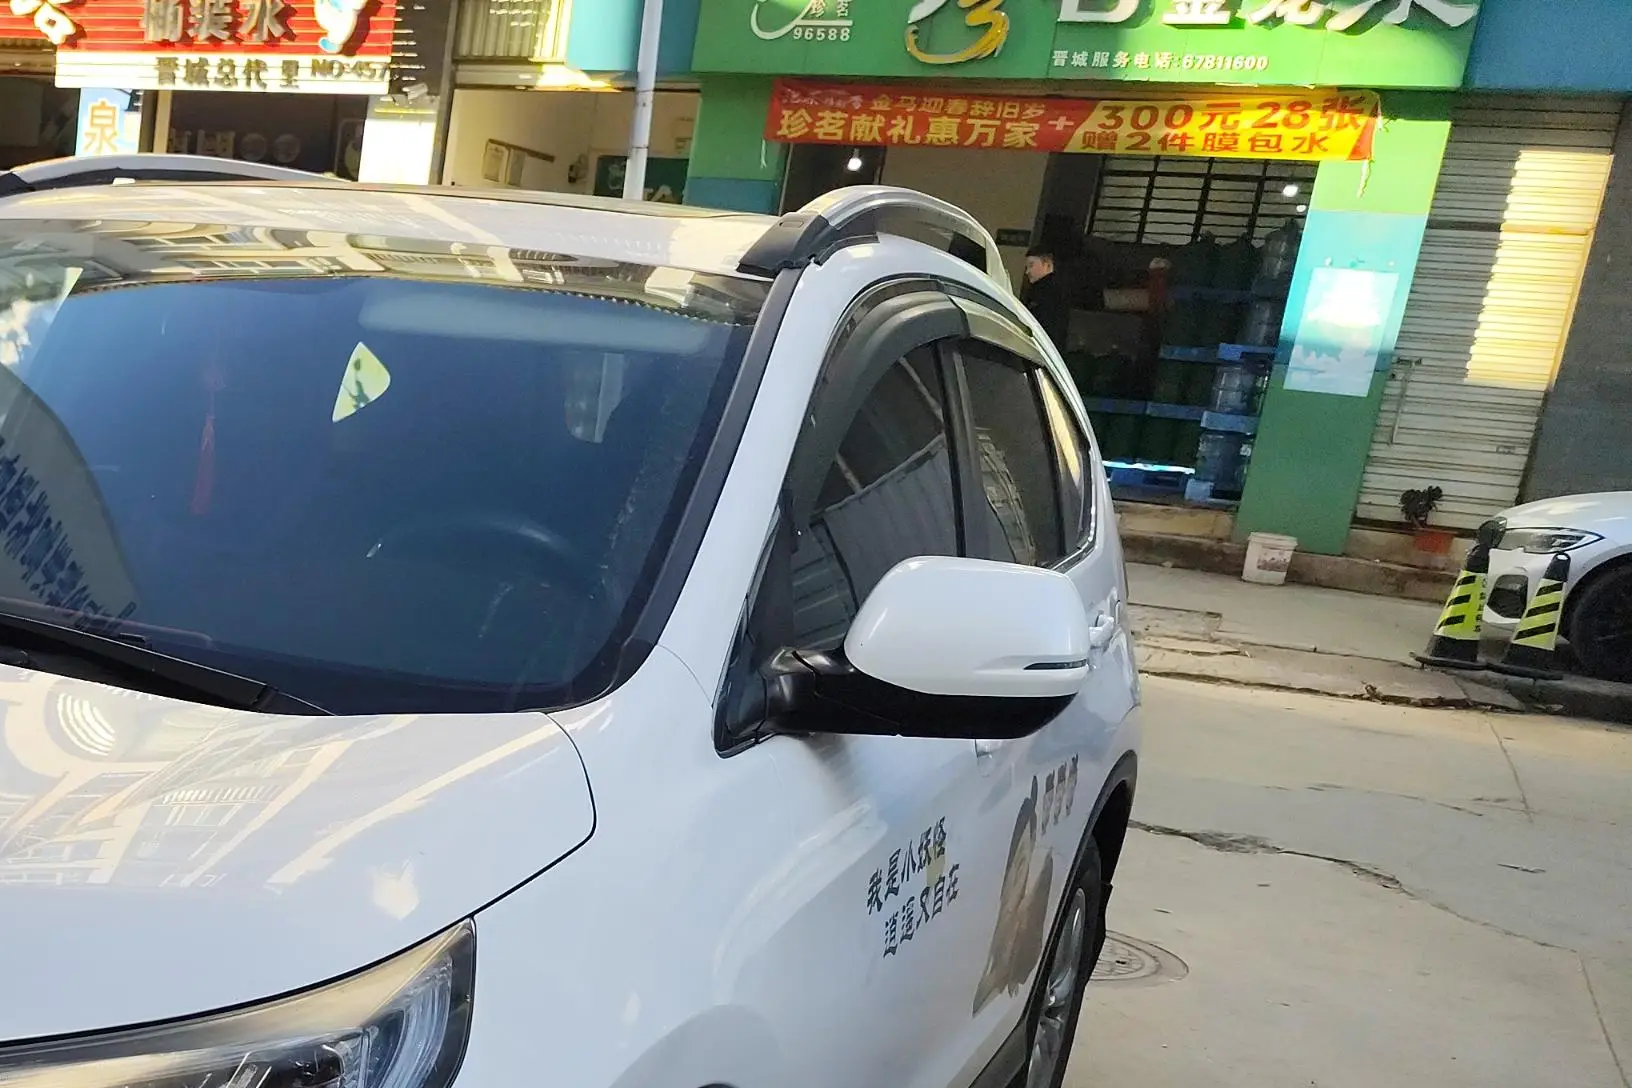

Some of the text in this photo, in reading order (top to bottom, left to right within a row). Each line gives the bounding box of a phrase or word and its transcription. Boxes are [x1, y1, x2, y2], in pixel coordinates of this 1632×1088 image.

[793, 27, 850, 42] 96588
[870, 94, 1046, 120] 金马迎春辞旧岁
[777, 108, 1041, 148] 珍茗献礼惠万家
[1081, 130, 1330, 154] 赠2件膜包水
[882, 863, 961, 958] 逍遥又自在
